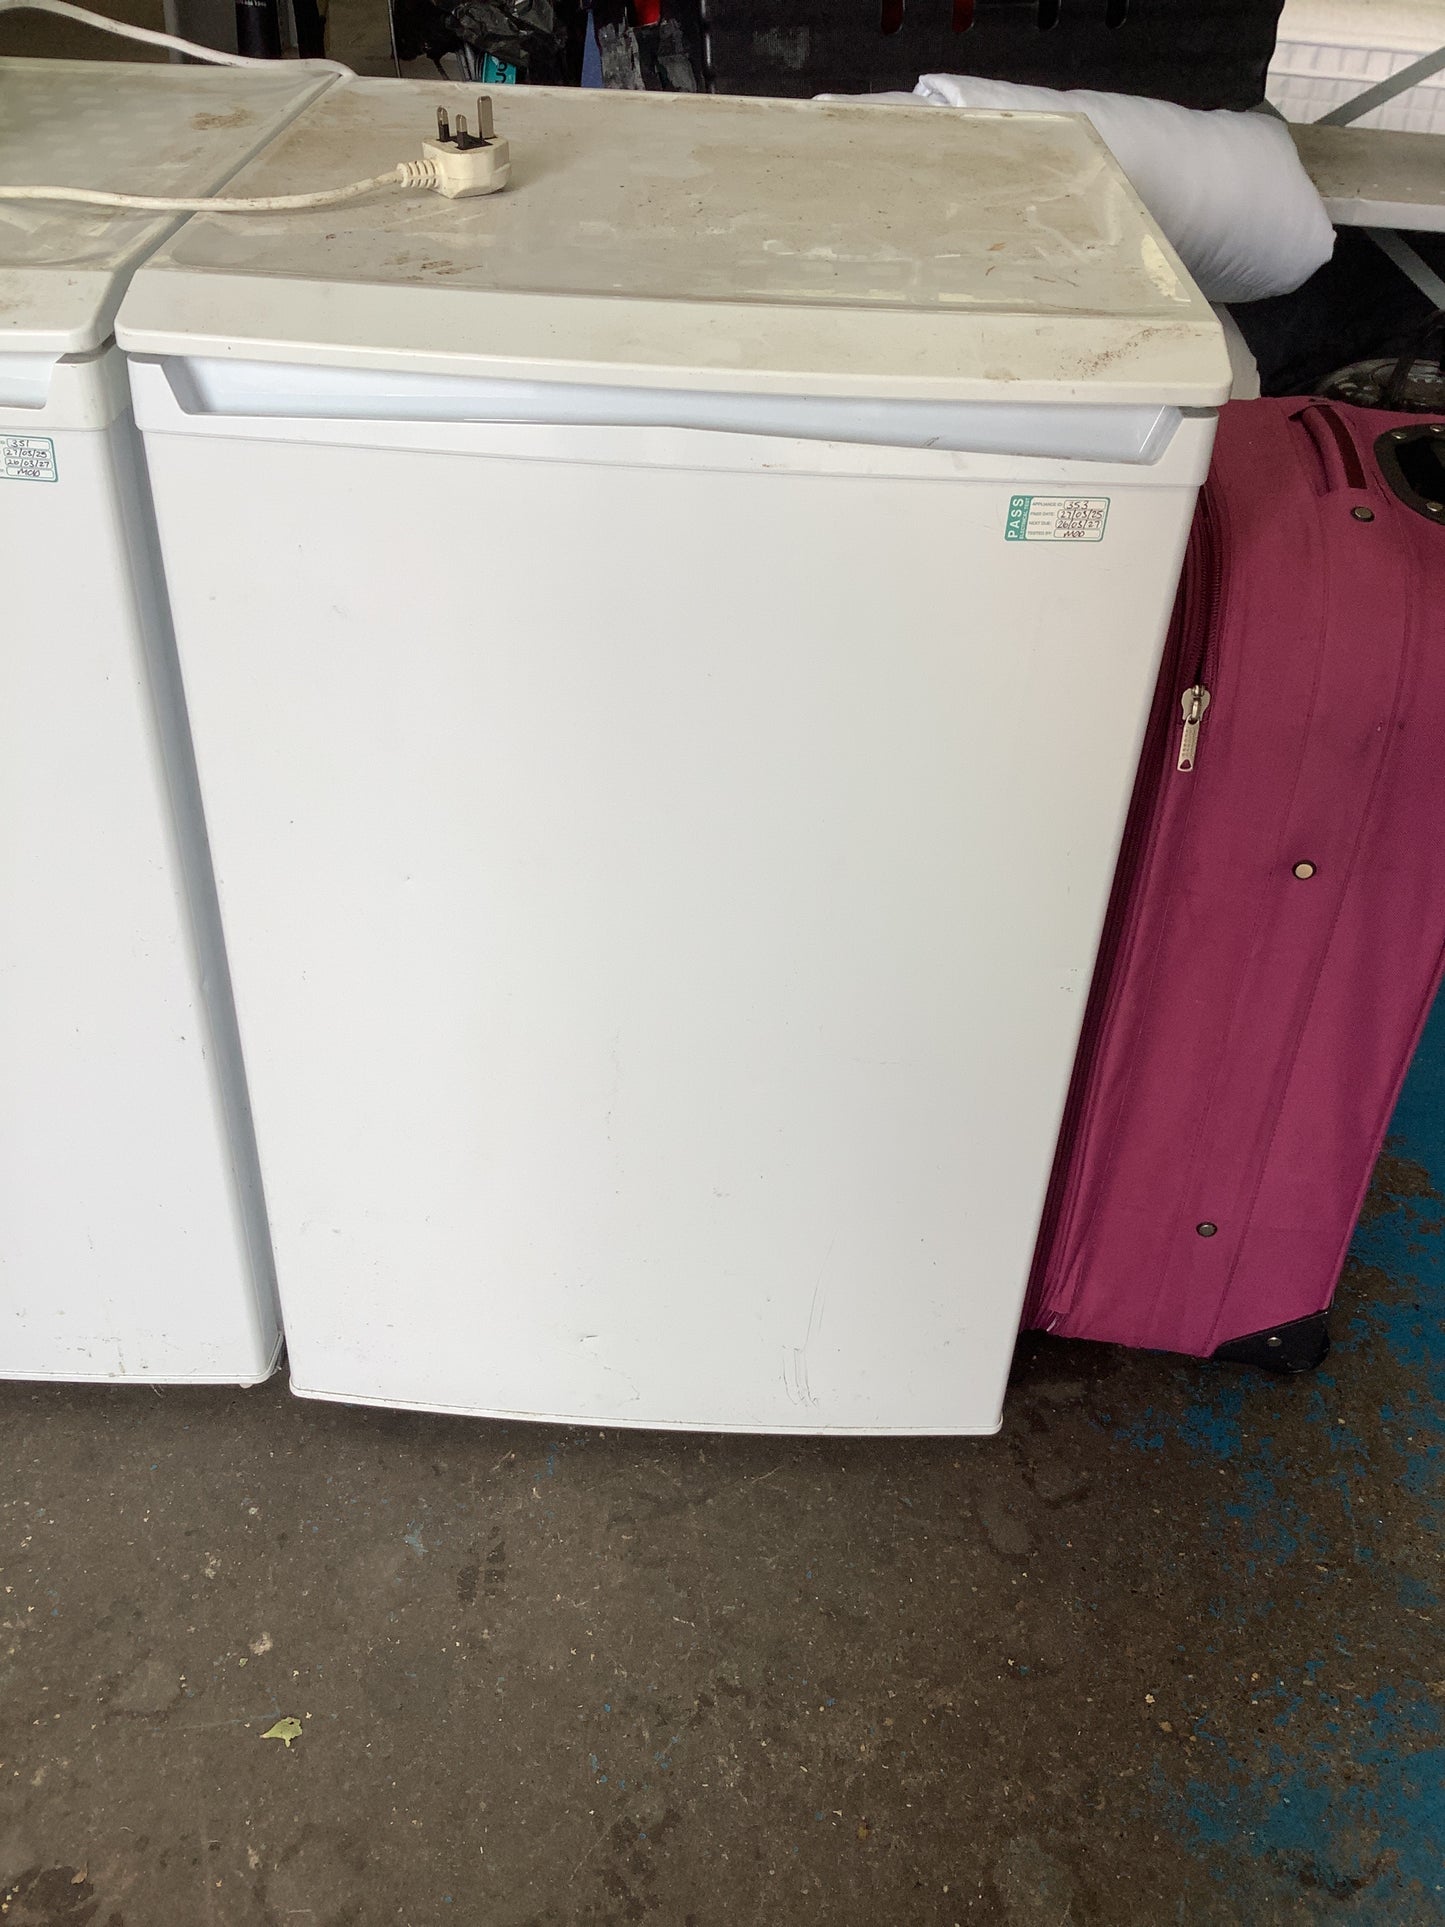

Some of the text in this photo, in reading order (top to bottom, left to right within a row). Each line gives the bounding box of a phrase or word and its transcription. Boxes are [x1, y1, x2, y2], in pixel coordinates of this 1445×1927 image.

[11, 439, 29, 448] 351
[1066, 500, 1090, 510] 353
[1007, 498, 1024, 539] PASS
